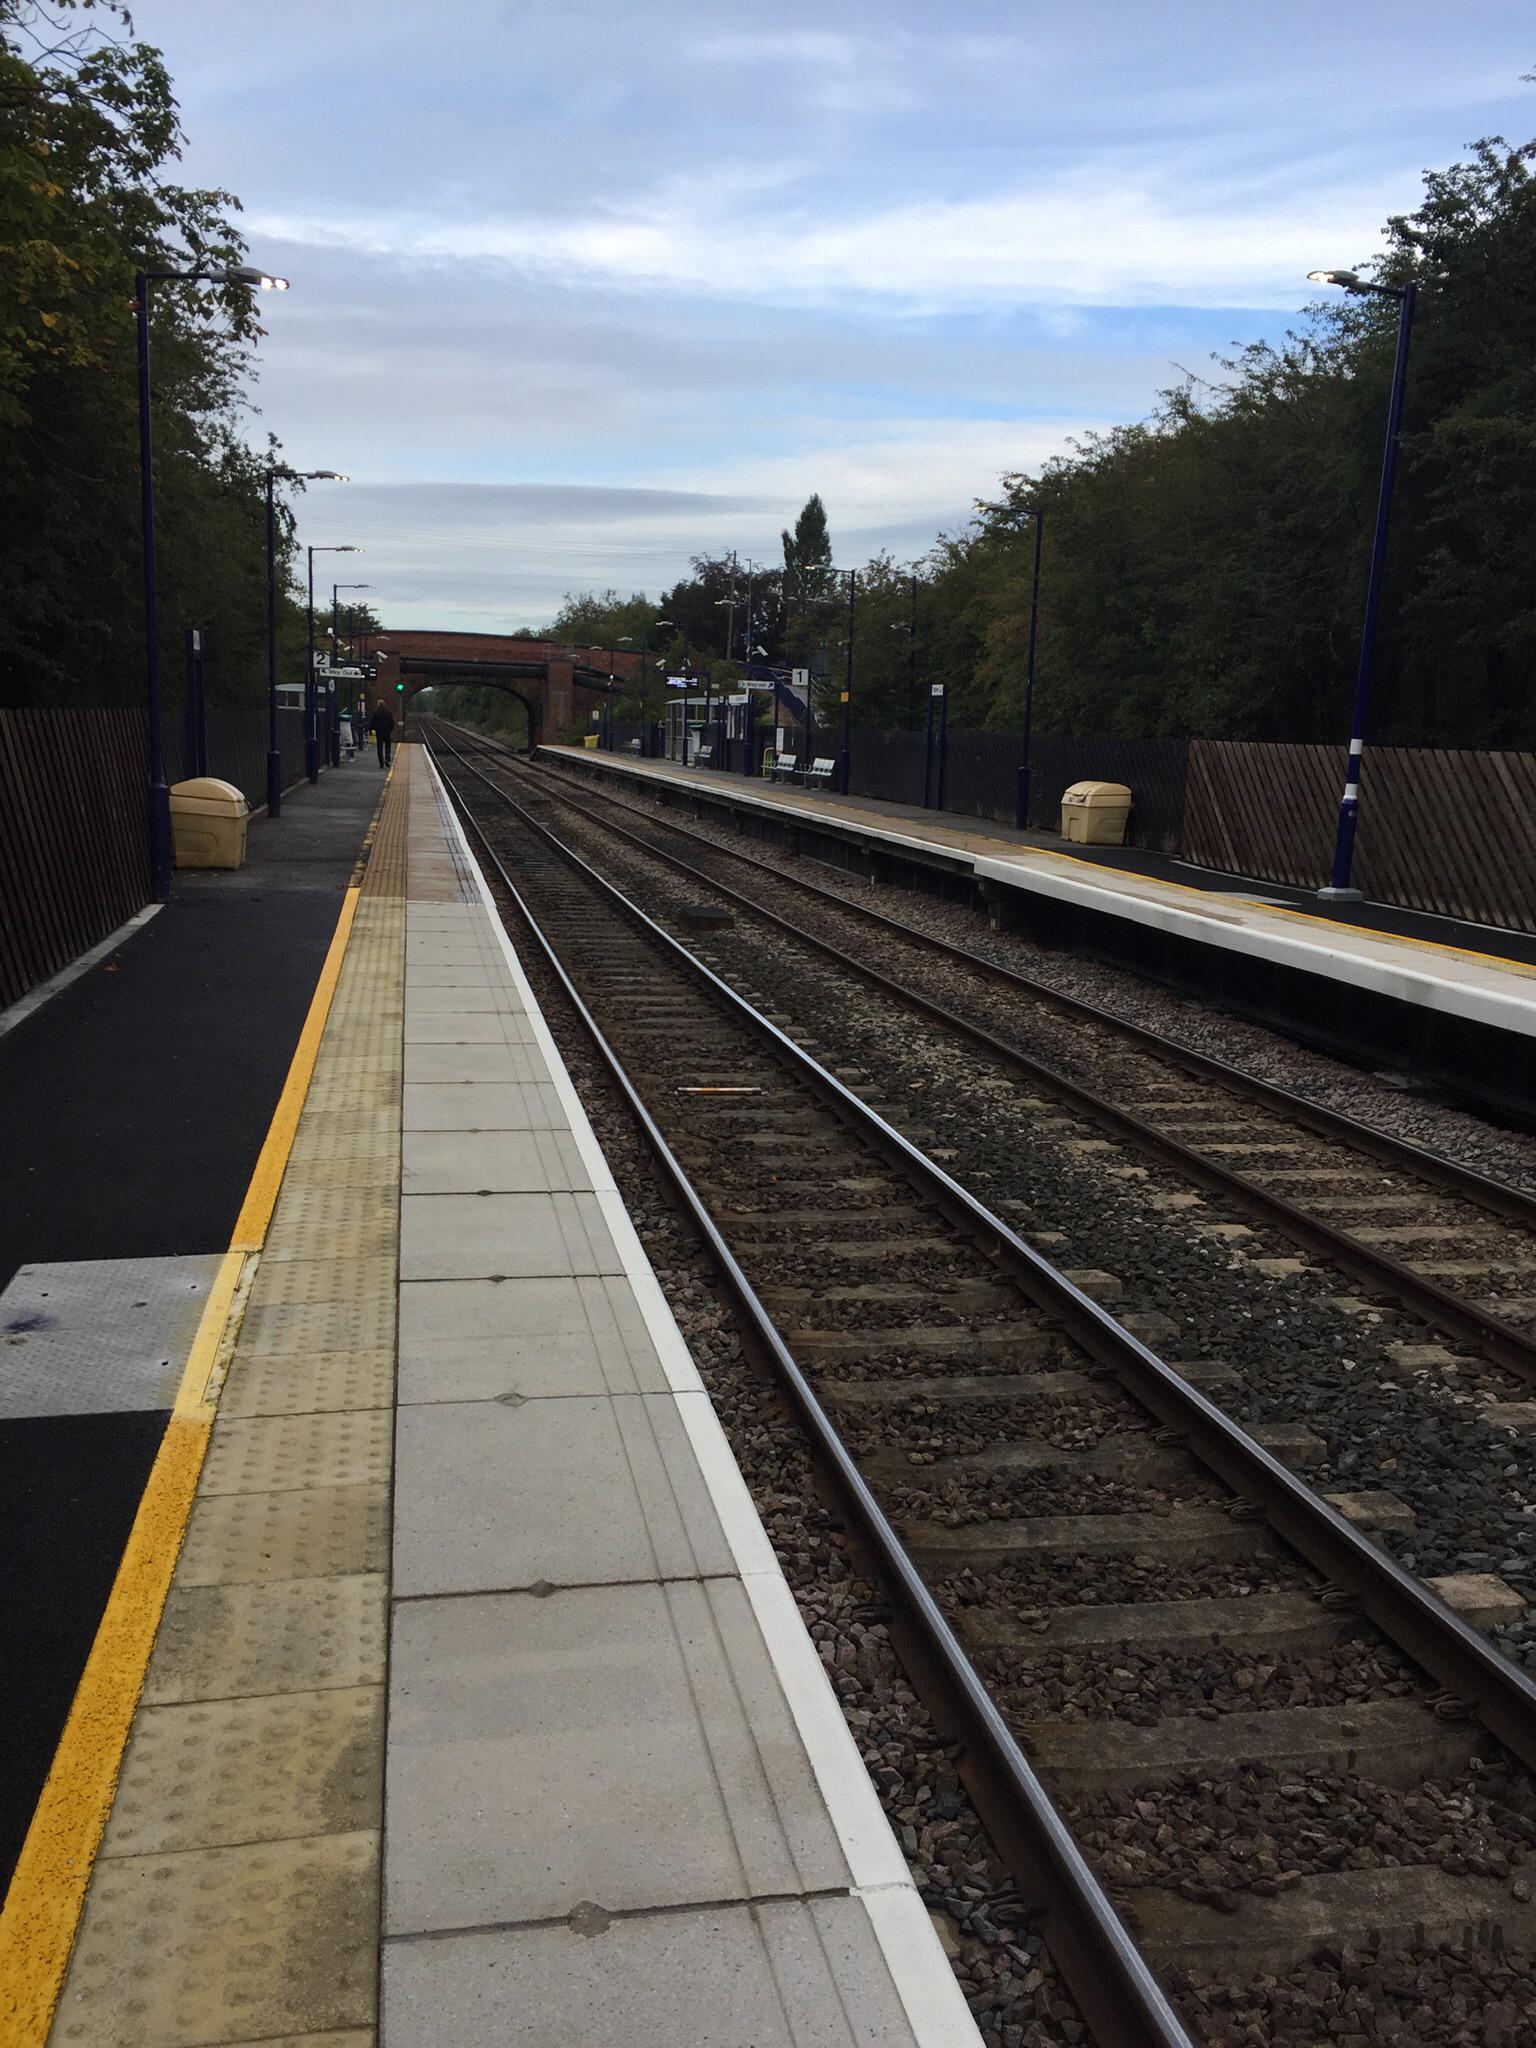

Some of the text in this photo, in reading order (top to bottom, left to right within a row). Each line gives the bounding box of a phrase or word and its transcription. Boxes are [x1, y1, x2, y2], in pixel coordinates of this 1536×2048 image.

[316, 653, 326, 665] 2
[328, 669, 341, 677] Way
[796, 671, 802, 683] 1
